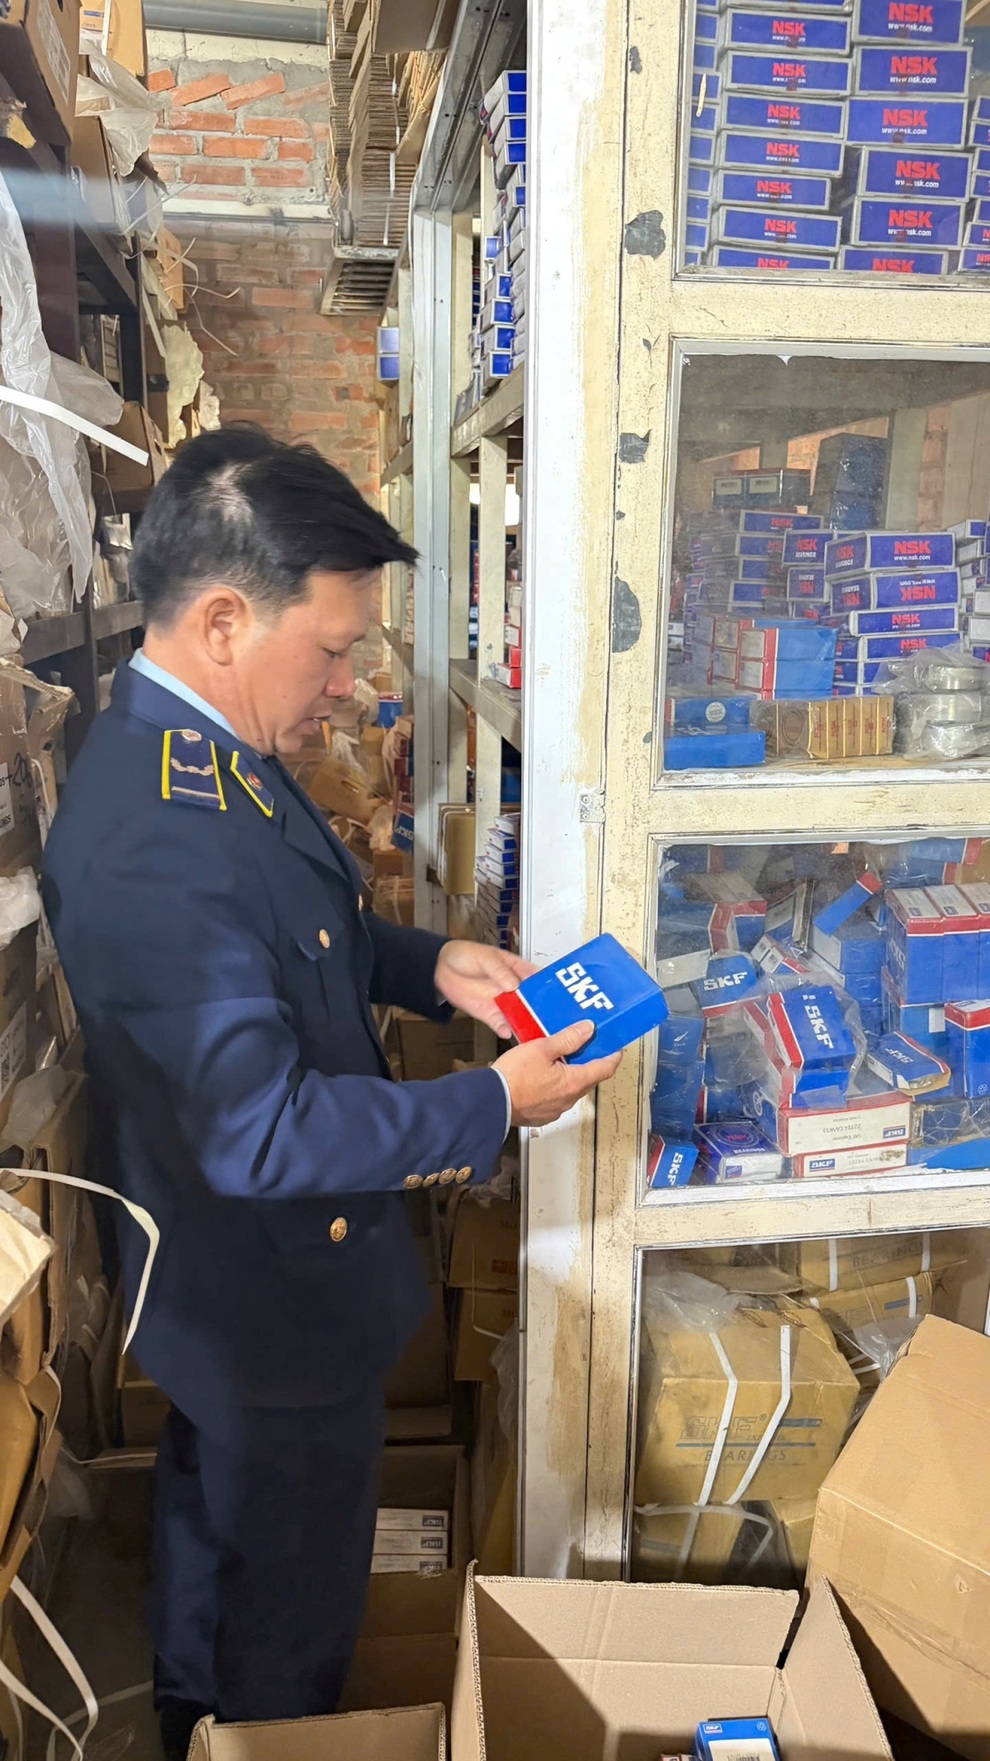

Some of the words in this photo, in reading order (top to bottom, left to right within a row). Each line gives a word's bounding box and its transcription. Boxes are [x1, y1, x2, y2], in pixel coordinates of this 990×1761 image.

[889, 2, 933, 24] NSK
[772, 21, 806, 36] NSK
[772, 63, 806, 77] NSK
[891, 57, 937, 75] NSK
[767, 104, 800, 119] NSK
[883, 109, 928, 127] NSK
[766, 143, 799, 157] NSK
[896, 160, 940, 180] NSK
[757, 181, 792, 194] NSK
[764, 219, 797, 234] NSK
[889, 210, 932, 229] NSK
[757, 258, 789, 270] NSK
[872, 259, 915, 273] NSK
[894, 541, 932, 555] NSK
[900, 585, 936, 601] NSK
[891, 613, 921, 625] NSK
[900, 638, 927, 650] NSK
[555, 962, 615, 1011] SKF
[703, 971, 748, 991] SKF
[804, 1005, 834, 1049] SKF
[885, 1047, 914, 1064] SKF
[883, 1127, 905, 1137] SKF
[667, 1152, 683, 1186] SKF
[811, 1159, 833, 1168] SKF
